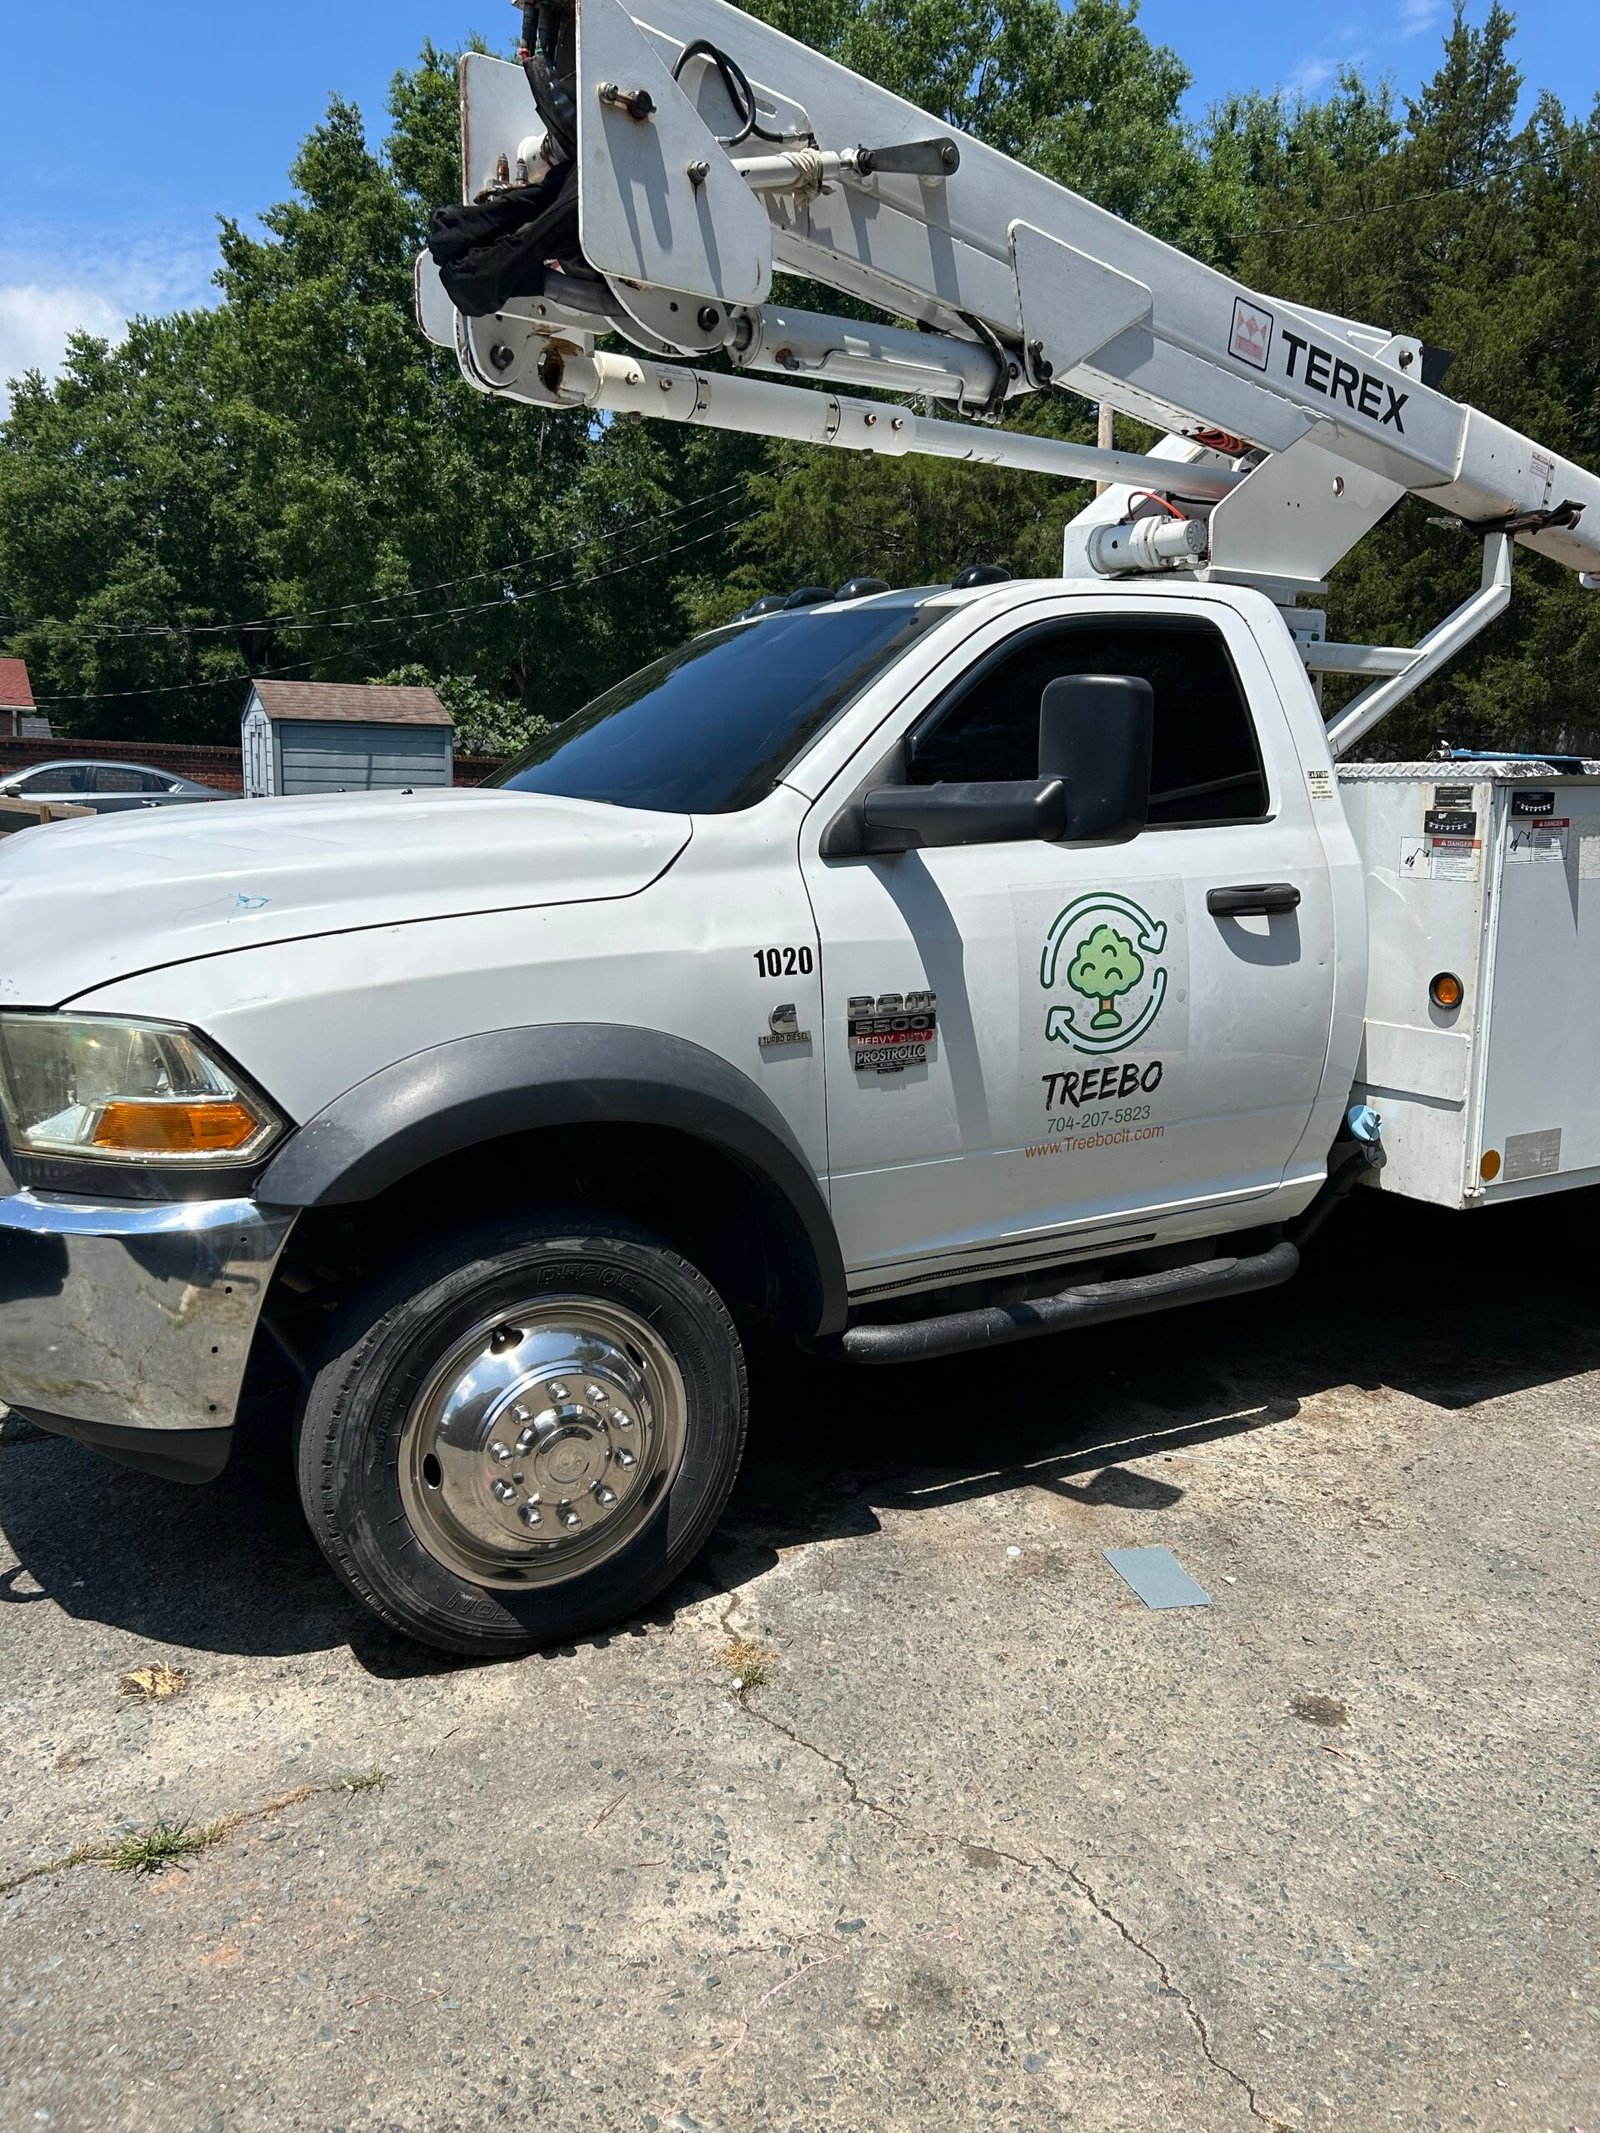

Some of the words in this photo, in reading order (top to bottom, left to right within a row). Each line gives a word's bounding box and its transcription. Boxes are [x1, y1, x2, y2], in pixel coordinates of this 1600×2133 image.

[1281, 329, 1410, 434] TEREX
[754, 946, 814, 978] 1020
[848, 991, 936, 1018] RAM
[763, 1034, 785, 1044] TURBO
[856, 1016, 930, 1035] 5500
[857, 1034, 895, 1046] HEAVY
[900, 1031, 928, 1042] DUTY
[857, 1045, 927, 1064] PROSTROLLO
[1042, 1060, 1163, 1111] TREEBO
[1047, 1105, 1151, 1133] 704-207-5823
[1024, 1125, 1165, 1158] www.Treeboclt.com
